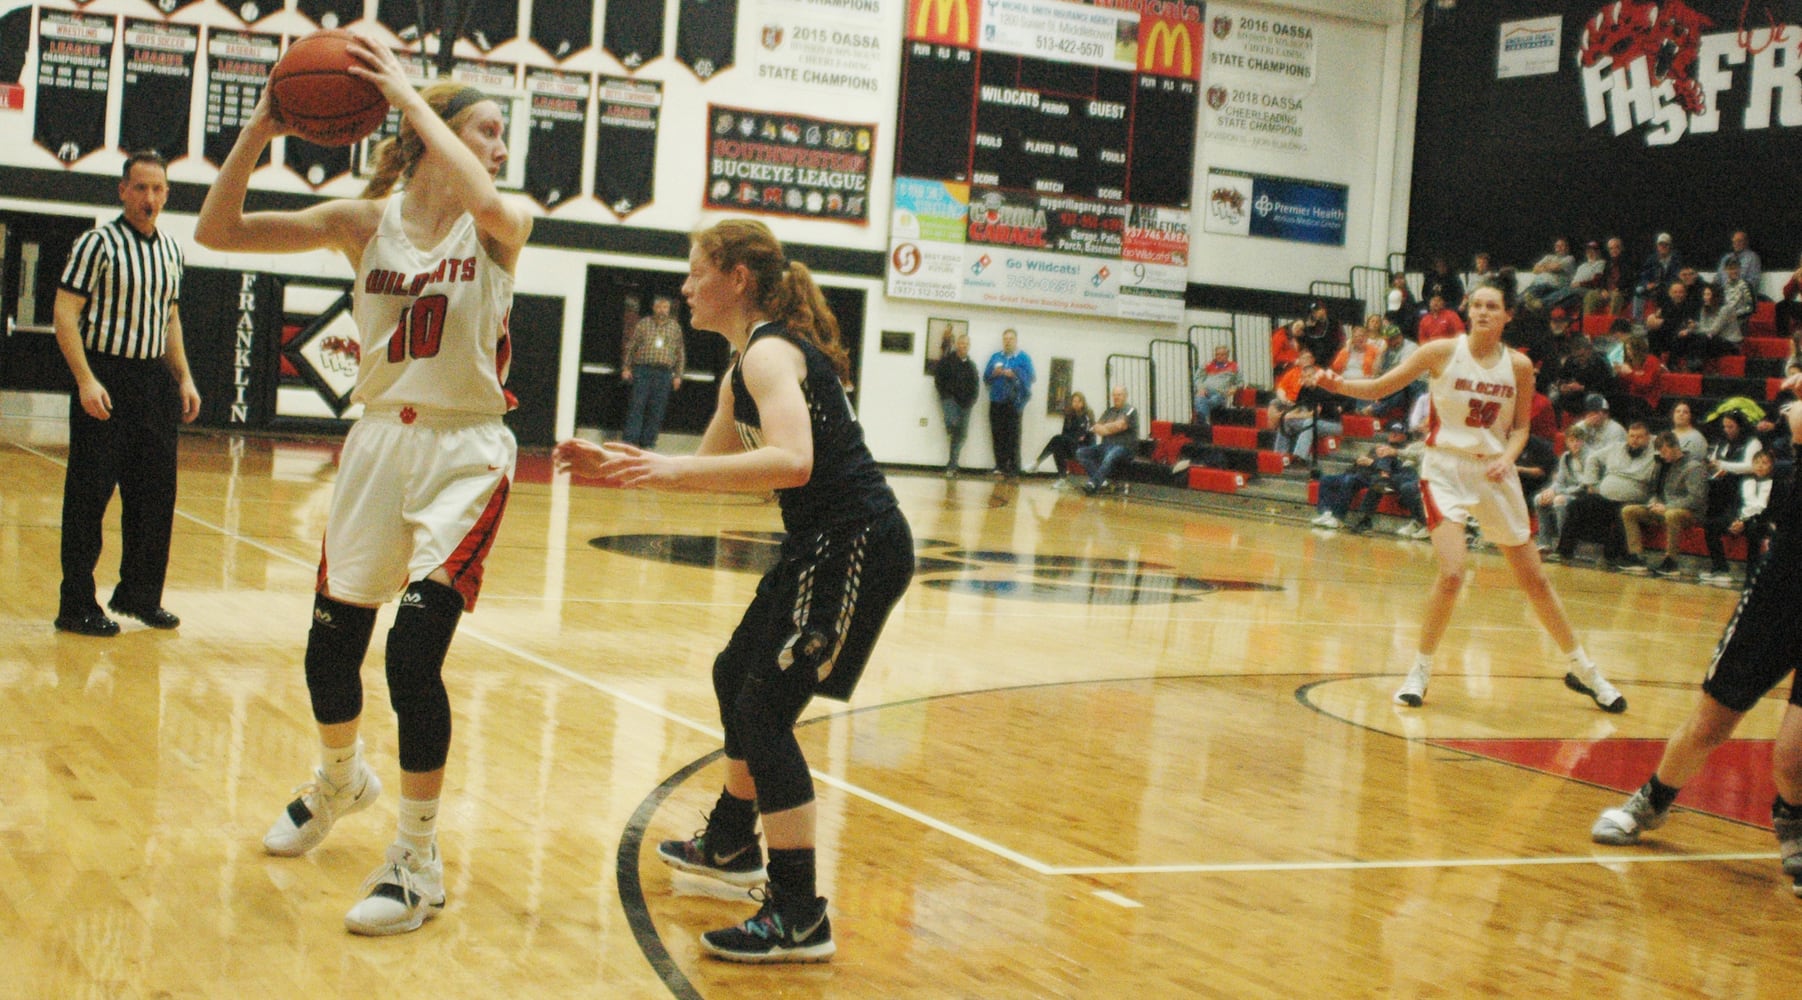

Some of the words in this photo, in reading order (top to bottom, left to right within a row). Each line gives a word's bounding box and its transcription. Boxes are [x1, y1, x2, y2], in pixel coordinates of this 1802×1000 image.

[1059, 23, 1114, 41] Middletown
[1239, 16, 1269, 33] 2016
[1271, 22, 1314, 40] OASSA
[792, 26, 828, 41] 2015
[831, 31, 881, 49] OASSA
[1036, 35, 1105, 58] 513-422-5570
[50, 41, 101, 56] LEAGUE
[42, 51, 107, 68] CHAMPIONSHIPS
[133, 50, 184, 66] LEAGUE
[1210, 51, 1245, 68] STATE
[1247, 55, 1312, 79] CHAMPIONS
[127, 61, 190, 77] CHAMPIONSHIPS
[217, 59, 267, 76] LEAGUE
[758, 64, 799, 81] STATE
[802, 69, 879, 92] CHAMPIONS
[533, 96, 578, 112] LEAGUE
[981, 85, 1040, 108] WILDCATS
[1231, 89, 1259, 105] 2018
[1262, 94, 1304, 112] OASSA
[1582, 54, 1689, 147] FHS
[607, 104, 651, 120] LEAGUE
[1041, 101, 1070, 115] PERIOD
[1088, 101, 1126, 119] GUEST
[1225, 106, 1298, 126] CHEERLEADING
[600, 116, 657, 130] CHAMPIONSHIPS
[1217, 116, 1247, 131] STATE
[1249, 119, 1304, 137] CHAMPIONS
[975, 133, 1003, 148] FOULS
[1025, 140, 1056, 154] PLAYER
[1058, 144, 1079, 158] FOUL
[713, 138, 867, 172] SOUTHWESTERN
[1101, 150, 1126, 163] FOULS
[712, 158, 794, 184] BUCKEYE
[797, 168, 866, 191] LEAGUE
[973, 172, 1000, 186] SCORE
[1036, 181, 1064, 193] MATCH
[1097, 188, 1123, 200] SCORE
[1039, 196, 1126, 217] mygorillagarage.com
[1274, 202, 1311, 217] Premier
[1312, 206, 1345, 221] Health
[1163, 232, 1188, 243] AREA
[1005, 257, 1022, 270] Go
[1026, 259, 1081, 276] Wildcats!
[387, 293, 449, 364] 10
[230, 273, 257, 424] FRANKLIN
